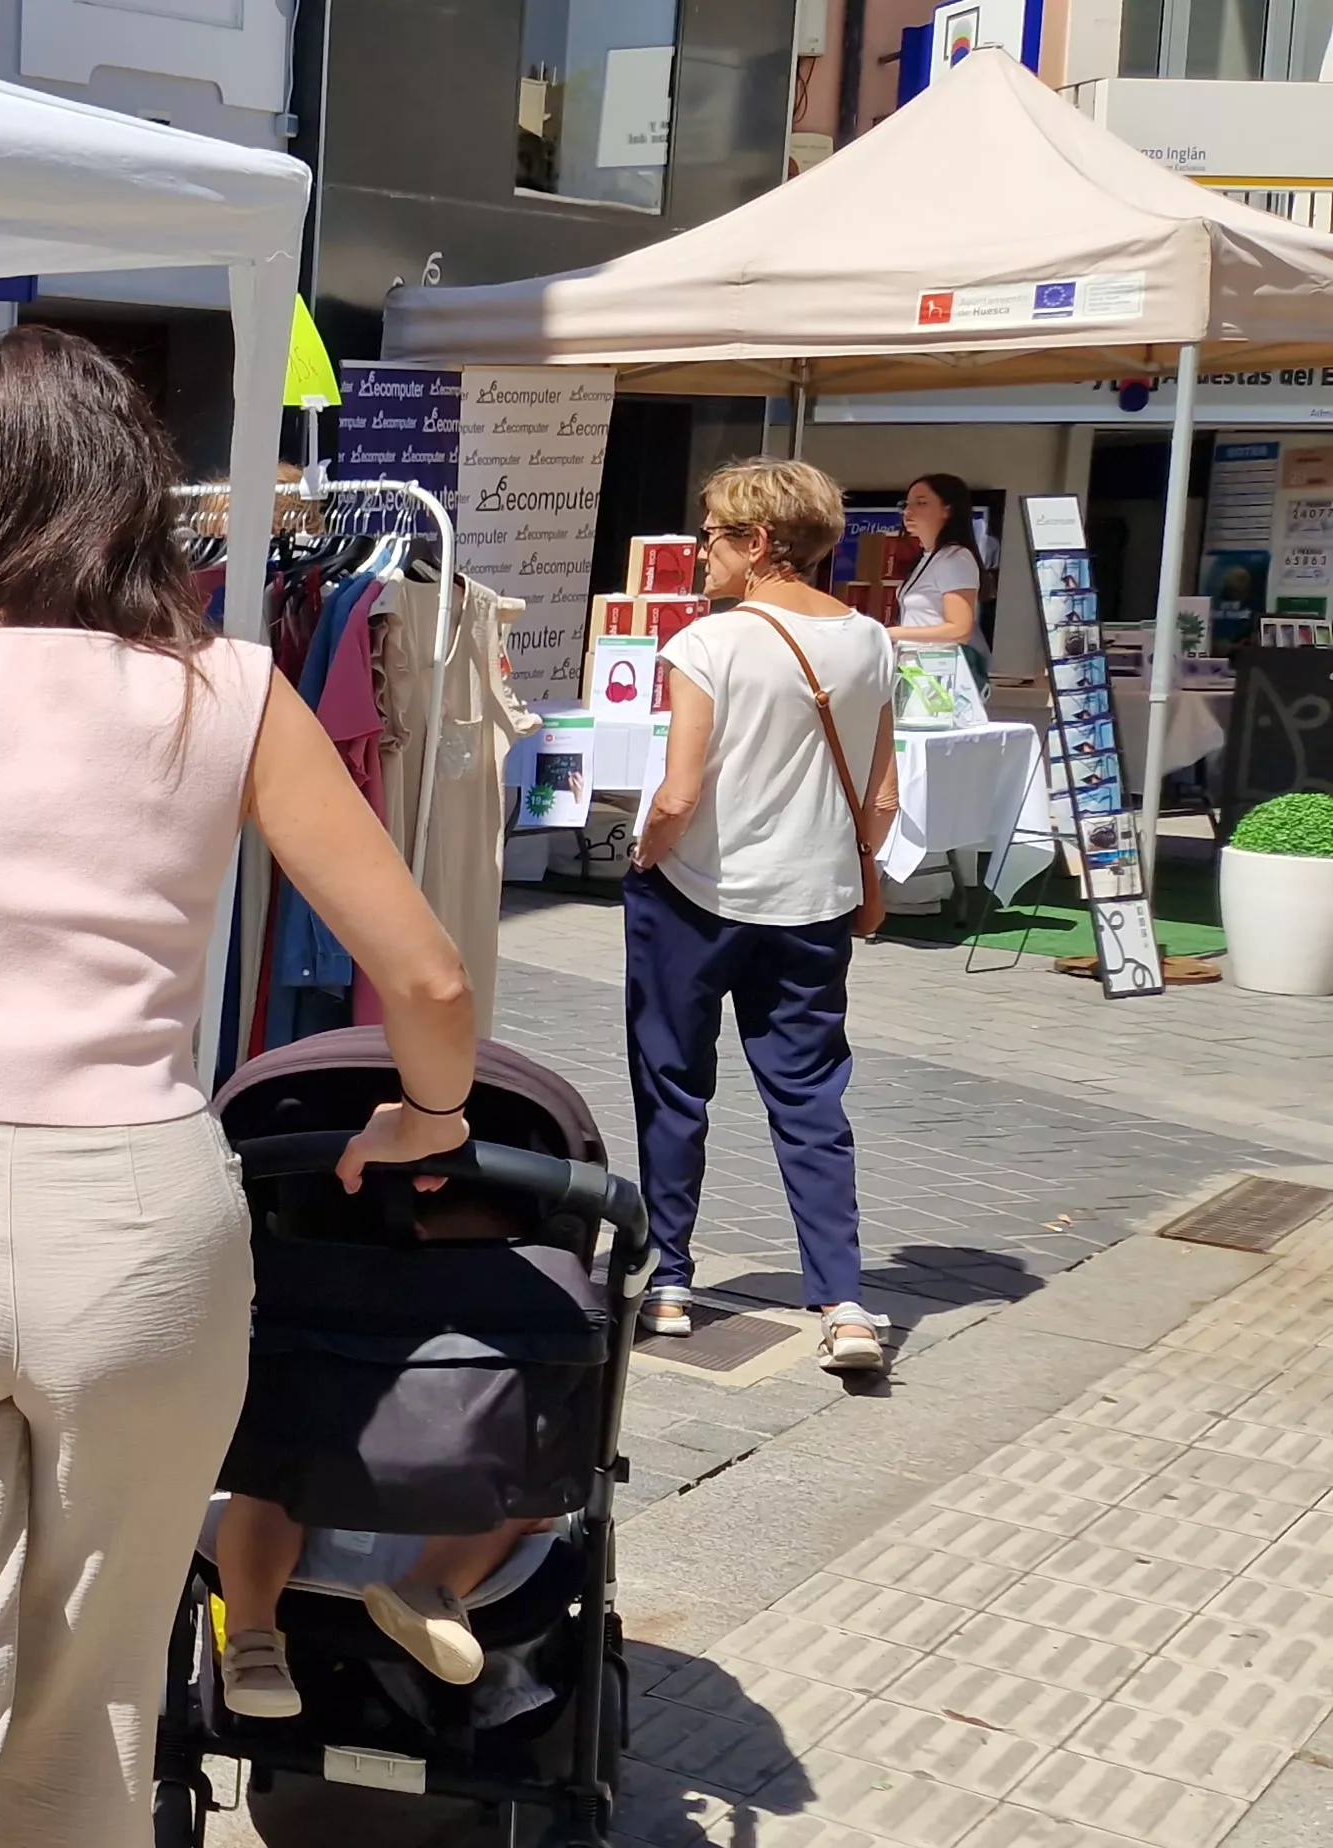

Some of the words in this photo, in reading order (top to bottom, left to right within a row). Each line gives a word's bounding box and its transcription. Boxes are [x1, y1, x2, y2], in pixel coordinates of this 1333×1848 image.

[1167, 146, 1206, 164] Inglán
[972, 306, 1010, 317] Huesca
[373, 380, 424, 401] ecomputer
[496, 388, 561, 407] ecomputer
[506, 422, 549, 435] ecomputer
[506, 485, 600, 516] ecomputer
